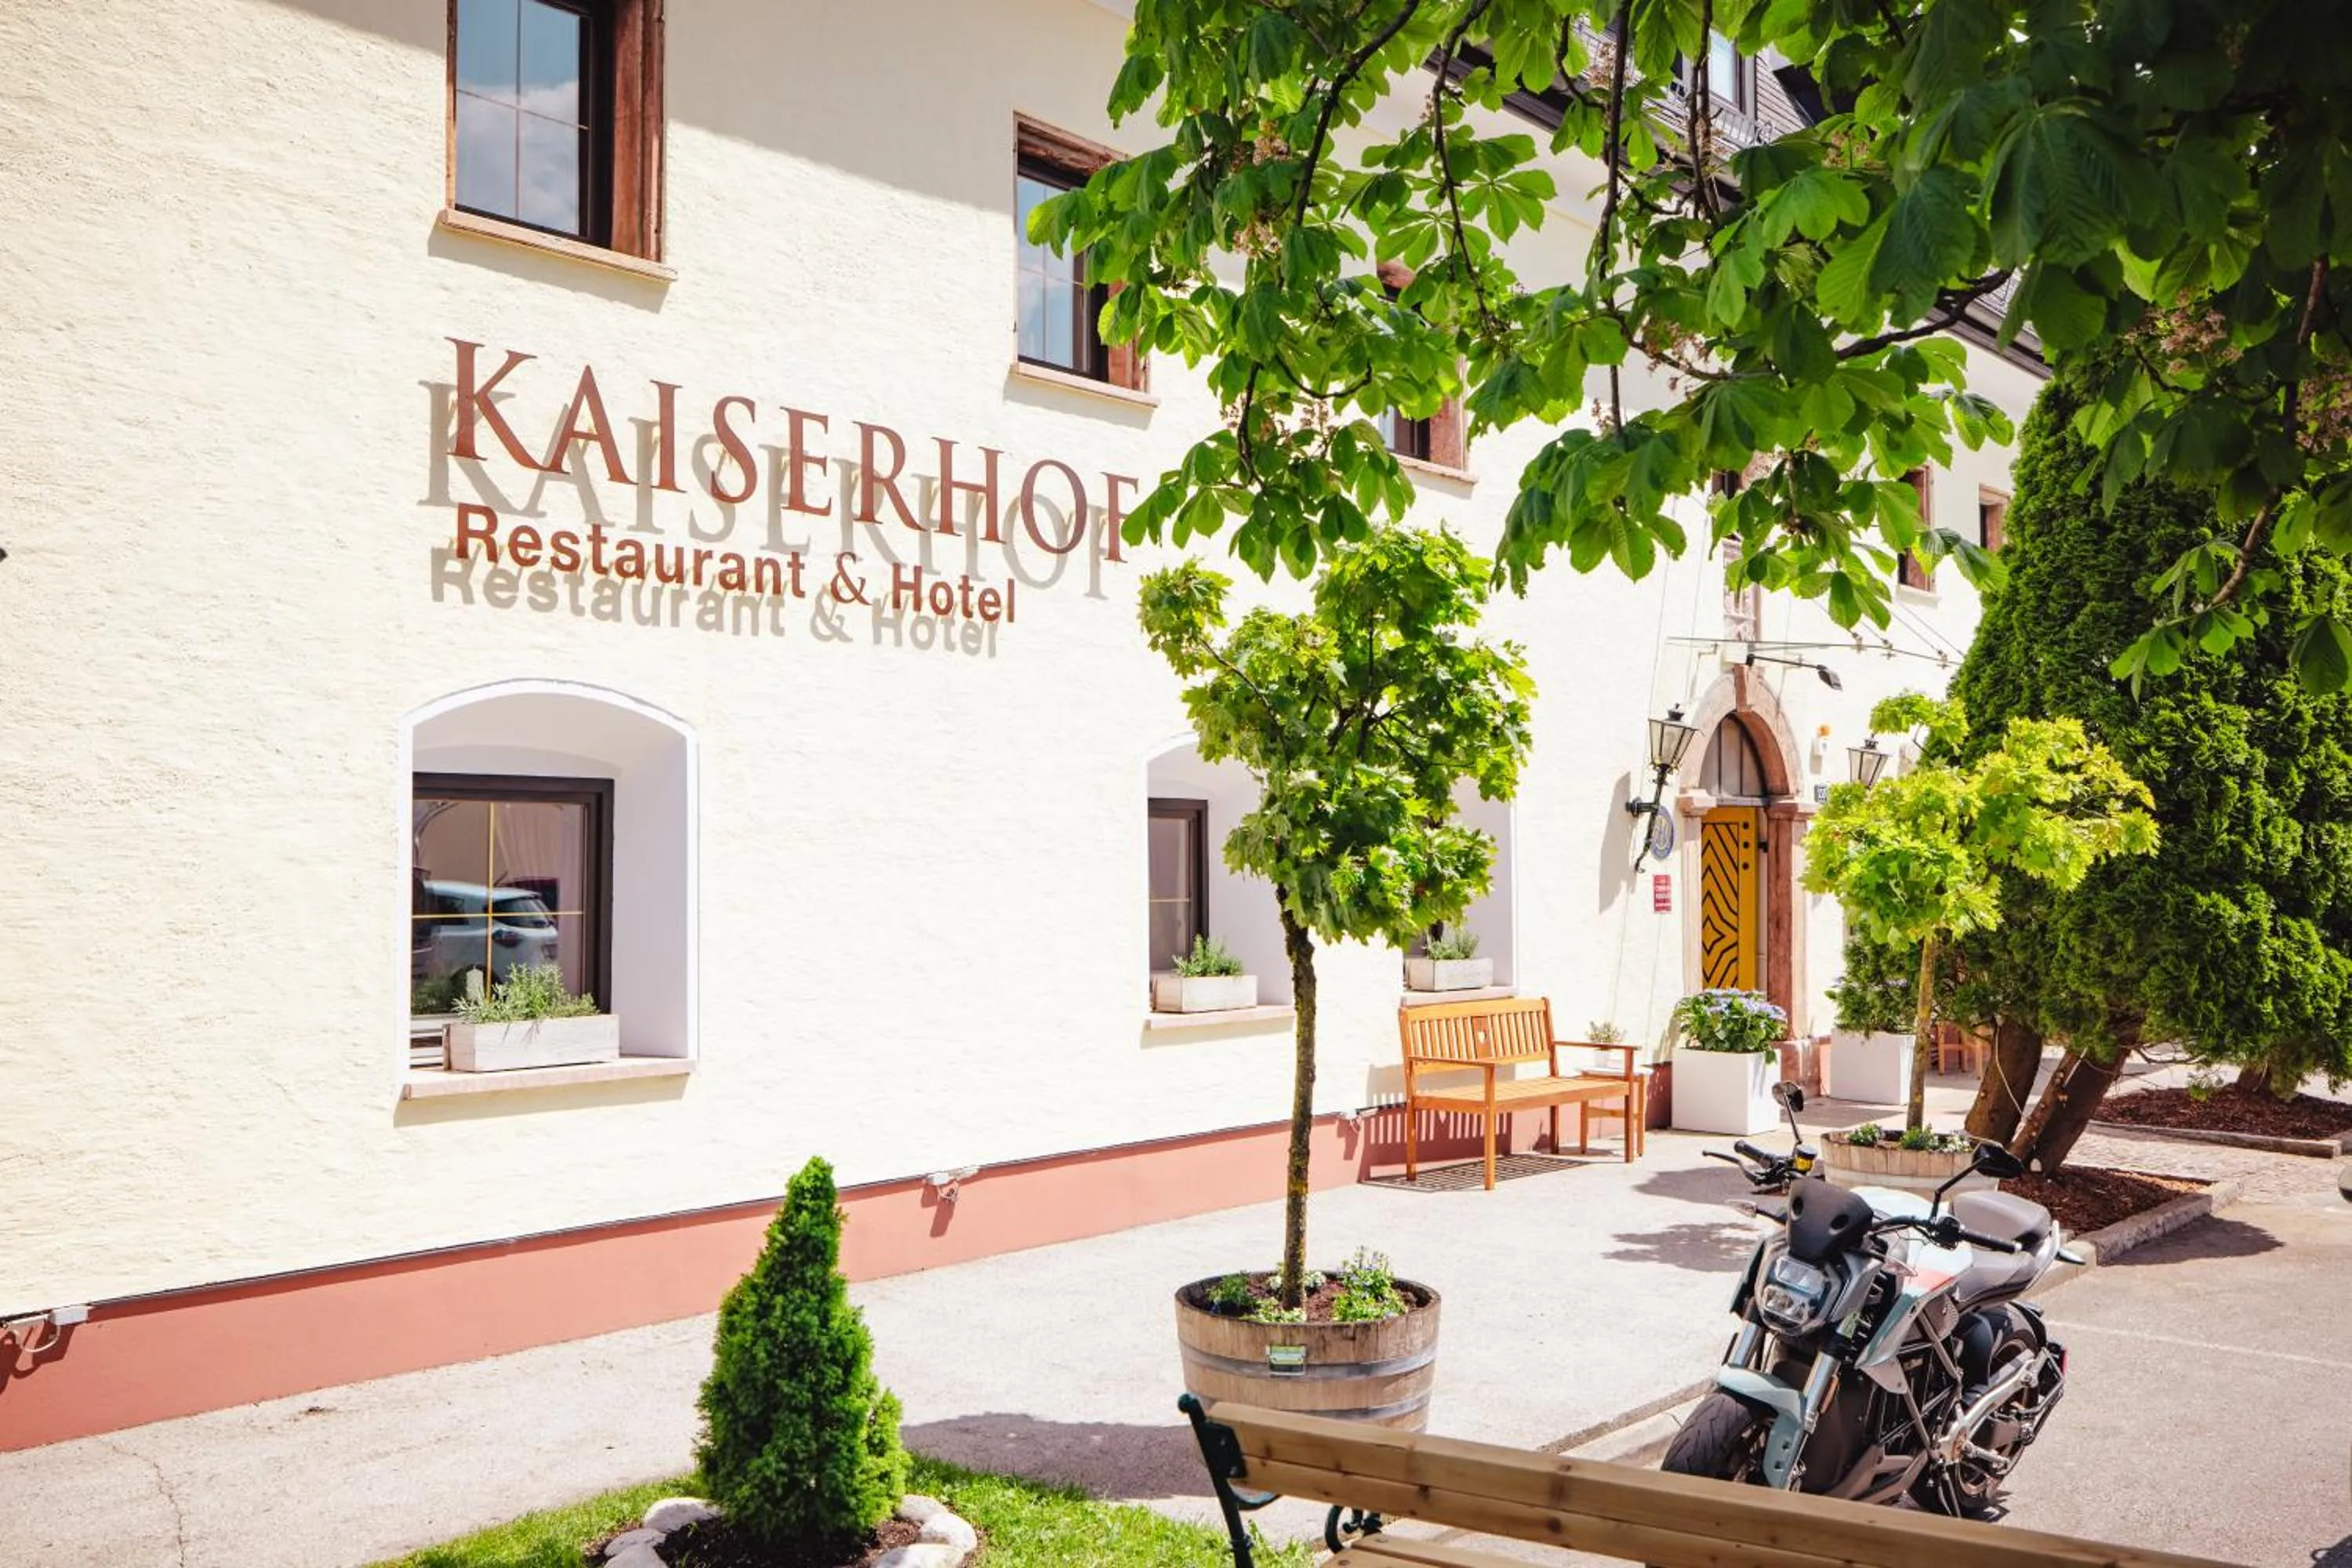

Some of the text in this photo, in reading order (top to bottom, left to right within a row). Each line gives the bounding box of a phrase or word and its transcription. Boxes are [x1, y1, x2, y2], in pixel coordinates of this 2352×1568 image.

[445, 336, 1138, 563] KAISERHOF
[456, 503, 1016, 623] Restaurant & Hotel
